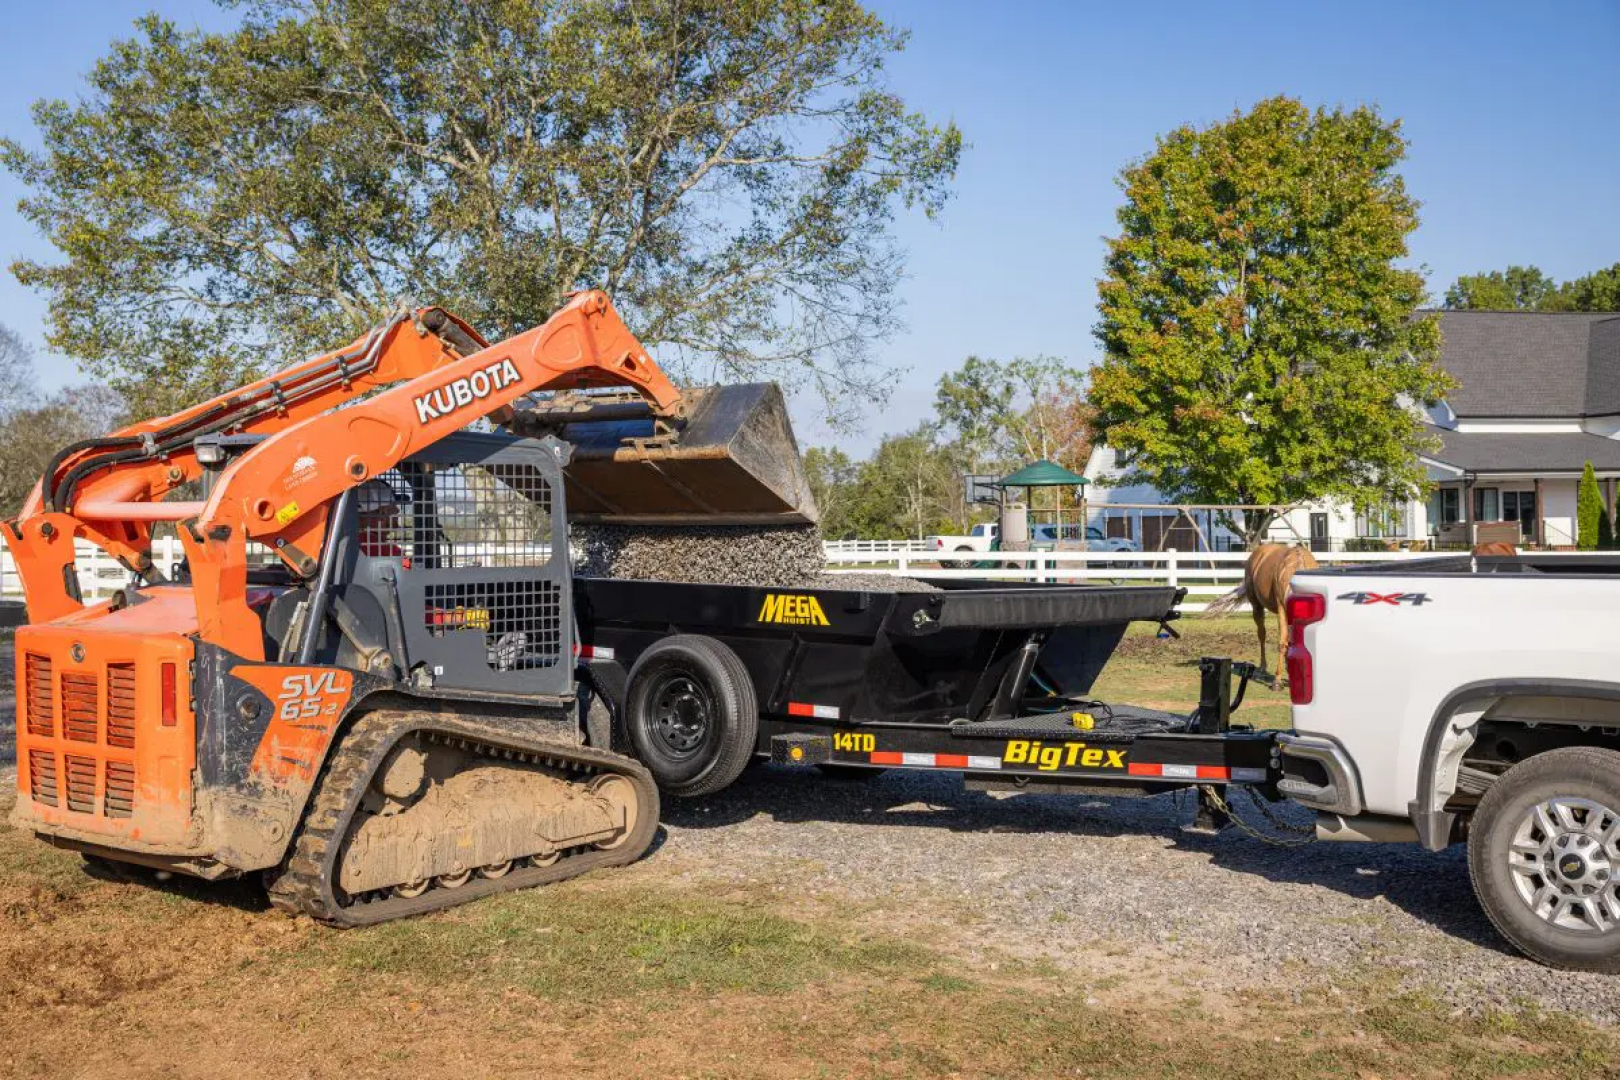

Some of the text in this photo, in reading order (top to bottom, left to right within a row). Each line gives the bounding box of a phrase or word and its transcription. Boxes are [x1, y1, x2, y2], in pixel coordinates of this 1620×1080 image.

[414, 358, 521, 424] KUBOTA
[757, 593, 831, 626] MEGA
[278, 671, 346, 699] SVL
[833, 732, 876, 752] 14TD
[1003, 739, 1127, 771] BigTex
